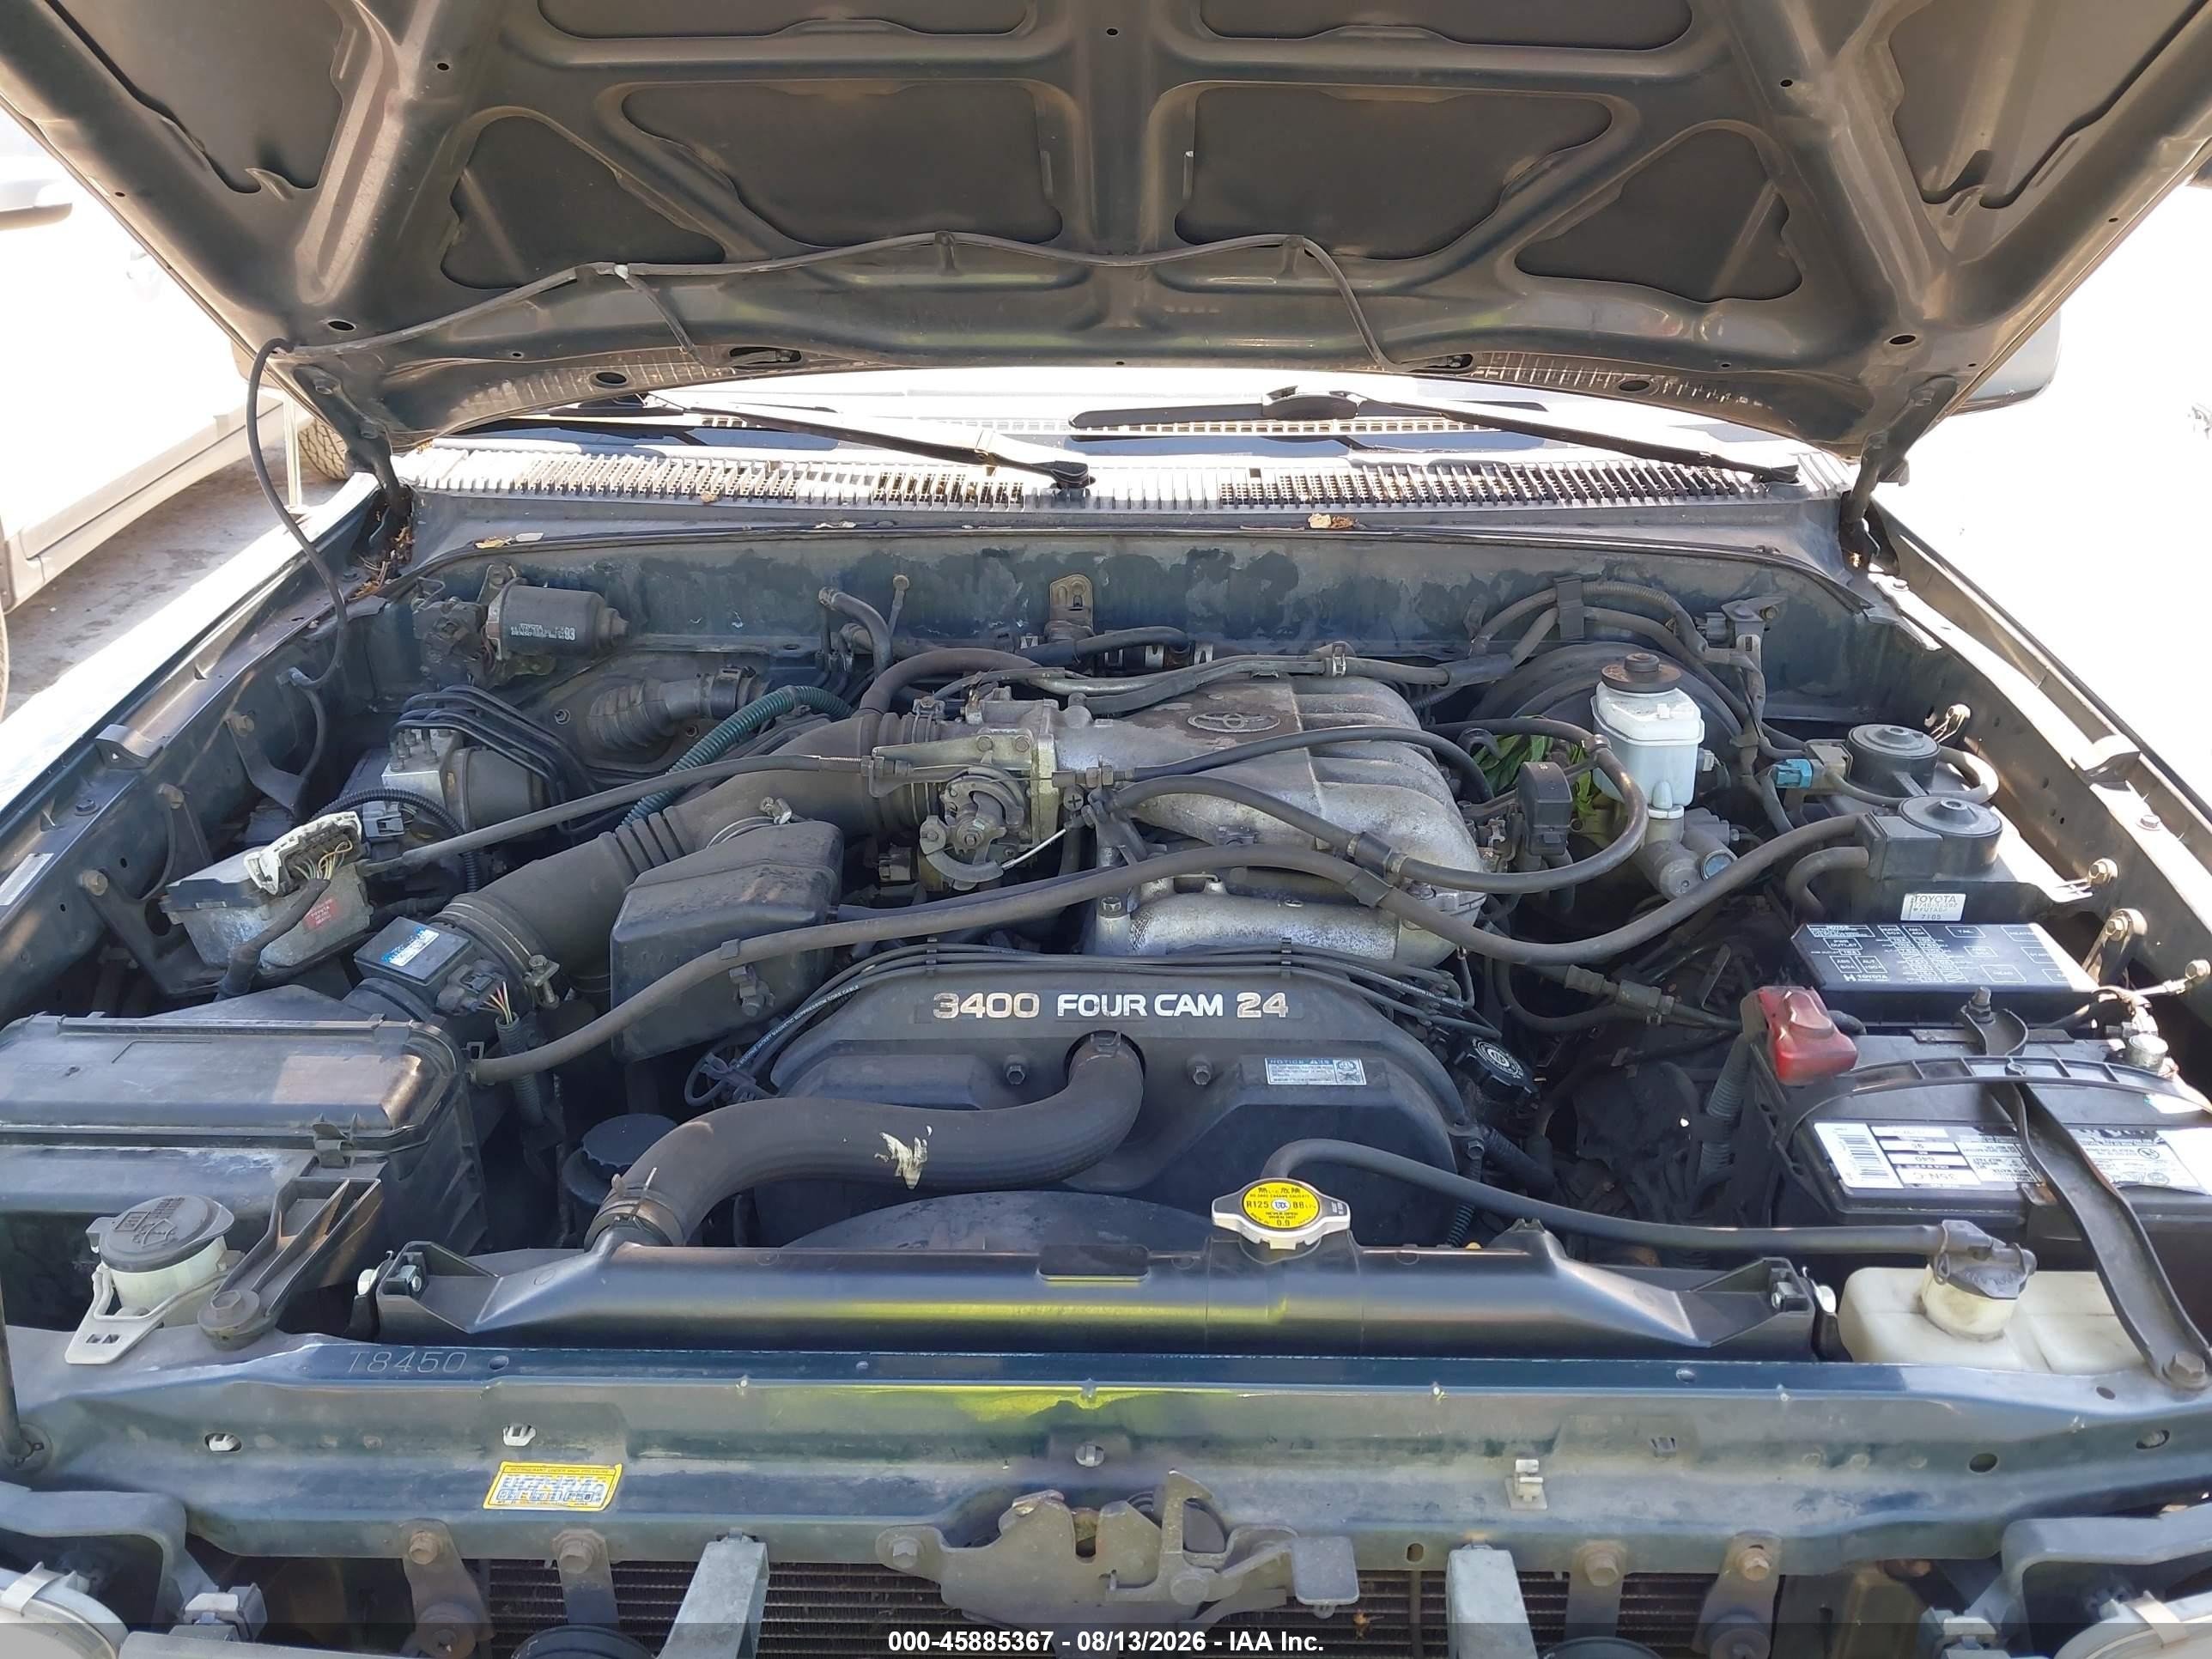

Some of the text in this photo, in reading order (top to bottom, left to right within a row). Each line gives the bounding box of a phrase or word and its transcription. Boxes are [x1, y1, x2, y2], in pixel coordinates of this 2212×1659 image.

[933, 992, 1288, 1019] 3400 FOUR CAM 24
[348, 1351, 467, 1374] T8450
